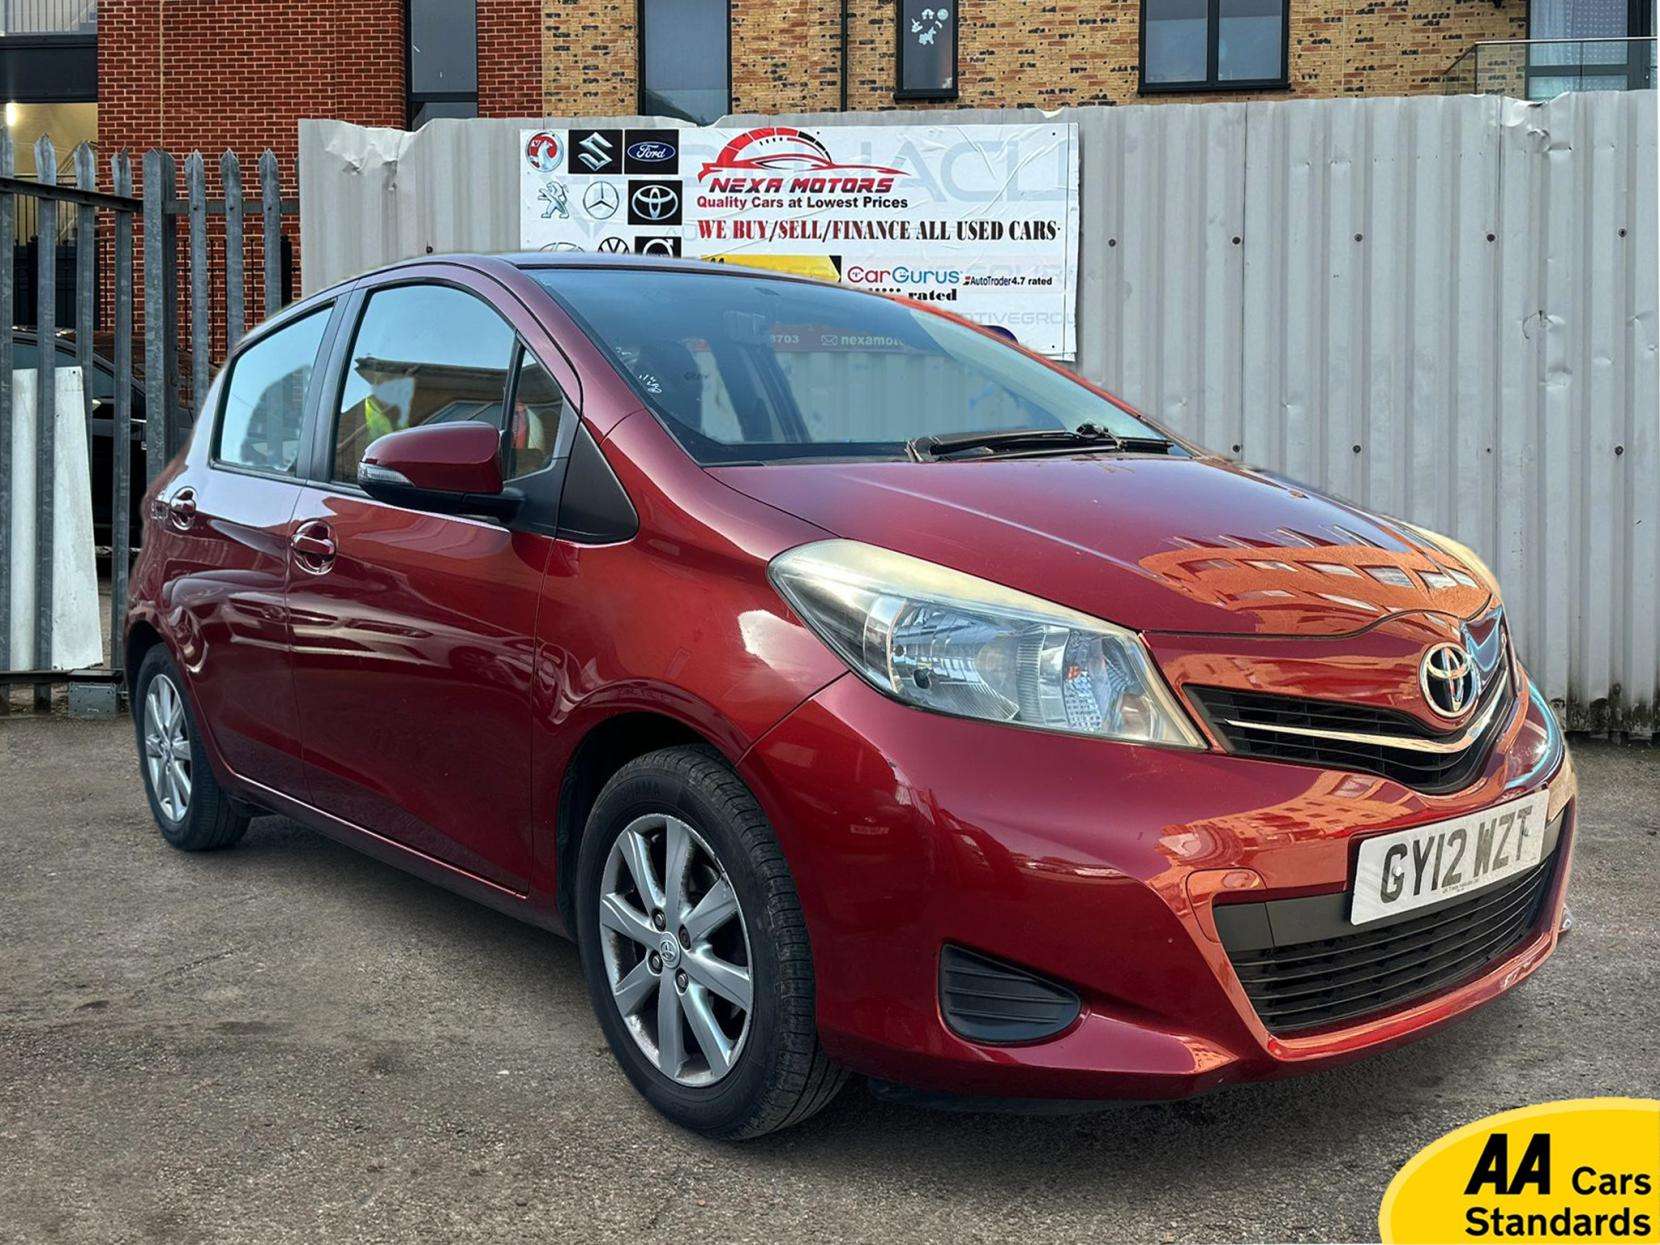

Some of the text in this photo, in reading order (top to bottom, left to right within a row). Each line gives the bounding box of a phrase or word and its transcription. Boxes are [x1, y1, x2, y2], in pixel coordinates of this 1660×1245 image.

[636, 144, 666, 159] Ford
[709, 177, 895, 194] NEXA MOTORS
[697, 195, 908, 210] Quality Cars at Lowest Prices
[698, 219, 727, 239] WE
[733, 219, 911, 243] BUY/SELL/FINANCE
[916, 220, 951, 240] ALL
[957, 220, 1003, 240] USED
[847, 265, 960, 284] CarGurus
[1028, 276, 1053, 286] rated
[908, 288, 958, 301] rated
[1380, 805, 1533, 903] GY12 WZT
